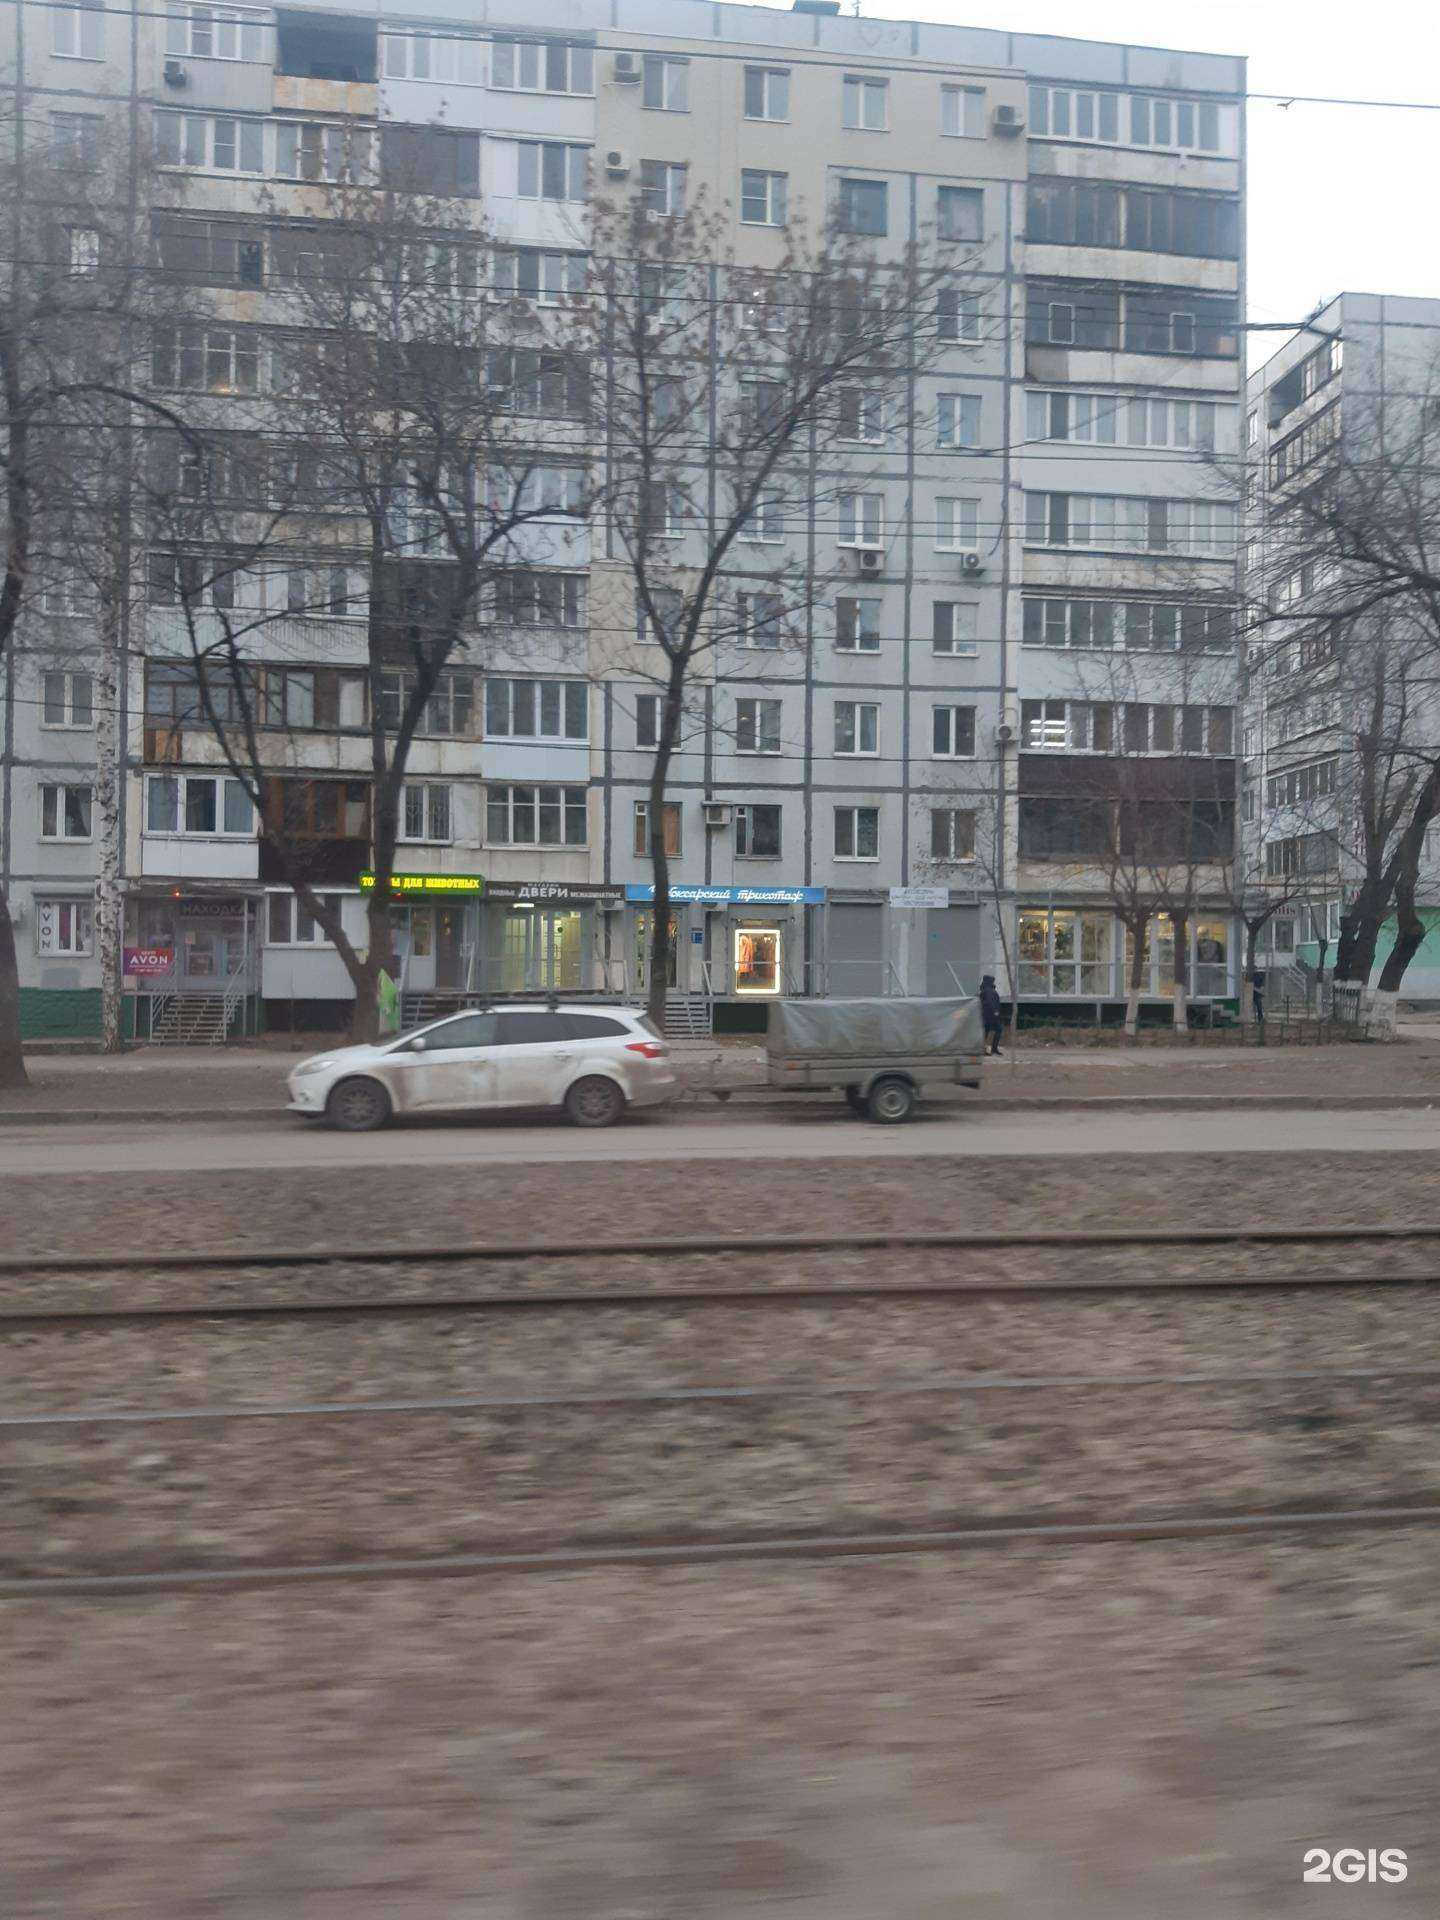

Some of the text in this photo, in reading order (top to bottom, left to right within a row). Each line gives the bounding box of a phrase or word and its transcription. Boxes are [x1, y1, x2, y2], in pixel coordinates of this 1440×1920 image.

[361, 876, 480, 889] ТОЫ ДЛЯ ЖИВОТНЫХ
[518, 886, 568, 898] ДВЕРИ
[130, 955, 168, 964] AVON
